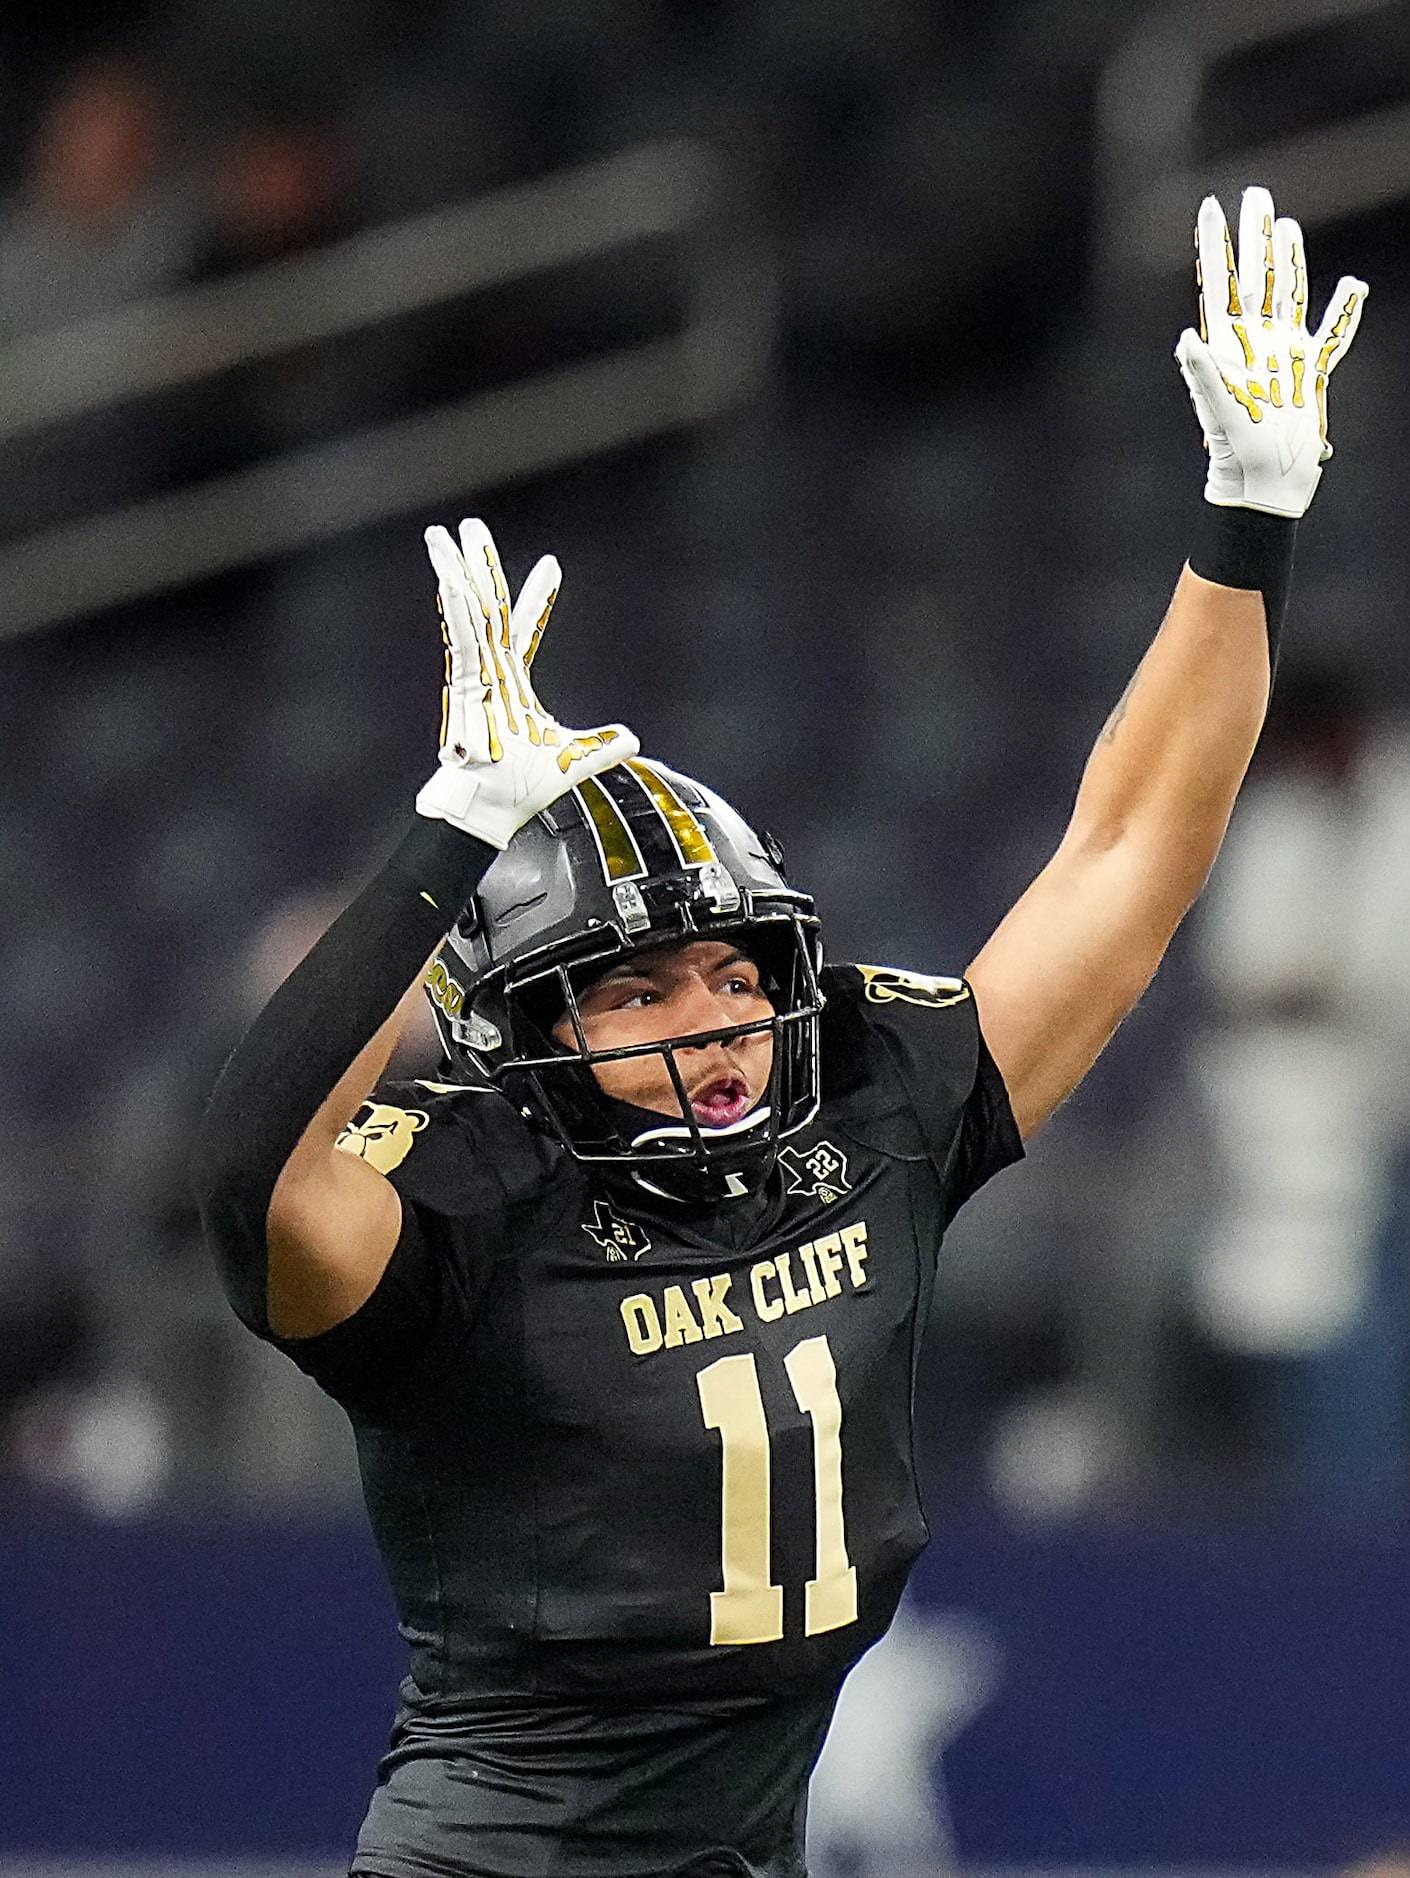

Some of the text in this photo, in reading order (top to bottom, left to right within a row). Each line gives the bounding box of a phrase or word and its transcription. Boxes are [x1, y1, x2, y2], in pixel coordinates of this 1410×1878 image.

[805, 1149, 839, 1180] 22
[611, 1222, 637, 1246] 21
[620, 1221, 868, 1356] OAK CLIFF
[696, 1335, 859, 1646] 11
